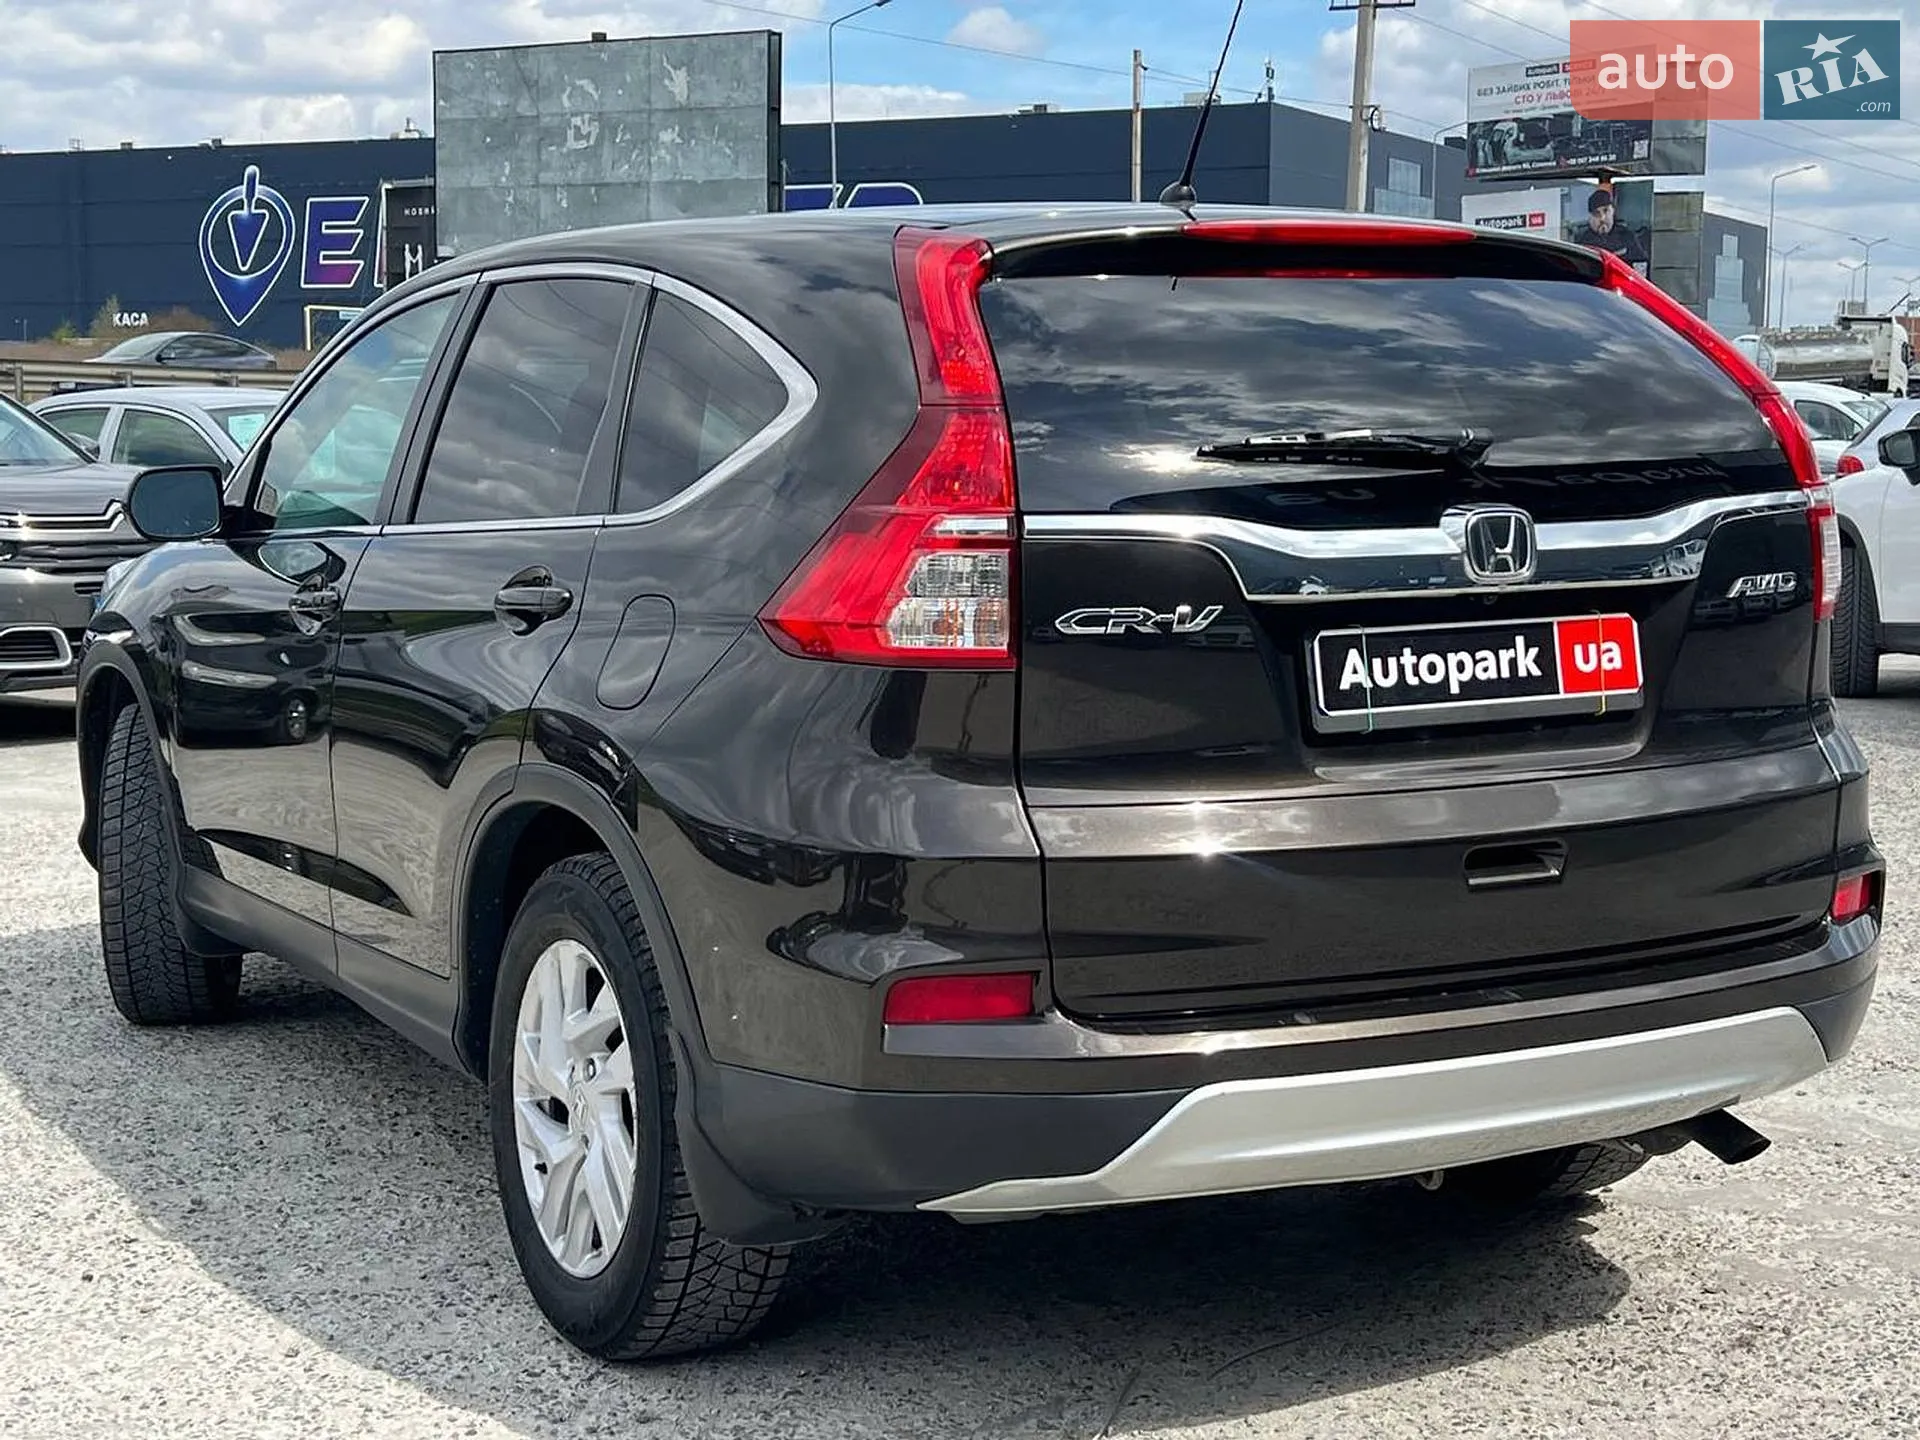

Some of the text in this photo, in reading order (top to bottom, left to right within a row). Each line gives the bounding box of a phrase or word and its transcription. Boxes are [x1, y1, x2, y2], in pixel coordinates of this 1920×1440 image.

[1514, 94, 1534, 105] СТО
[112, 311, 149, 327] КАСА
[1055, 605, 1224, 634] CR-V
[1338, 635, 1623, 694] Autopark ua
